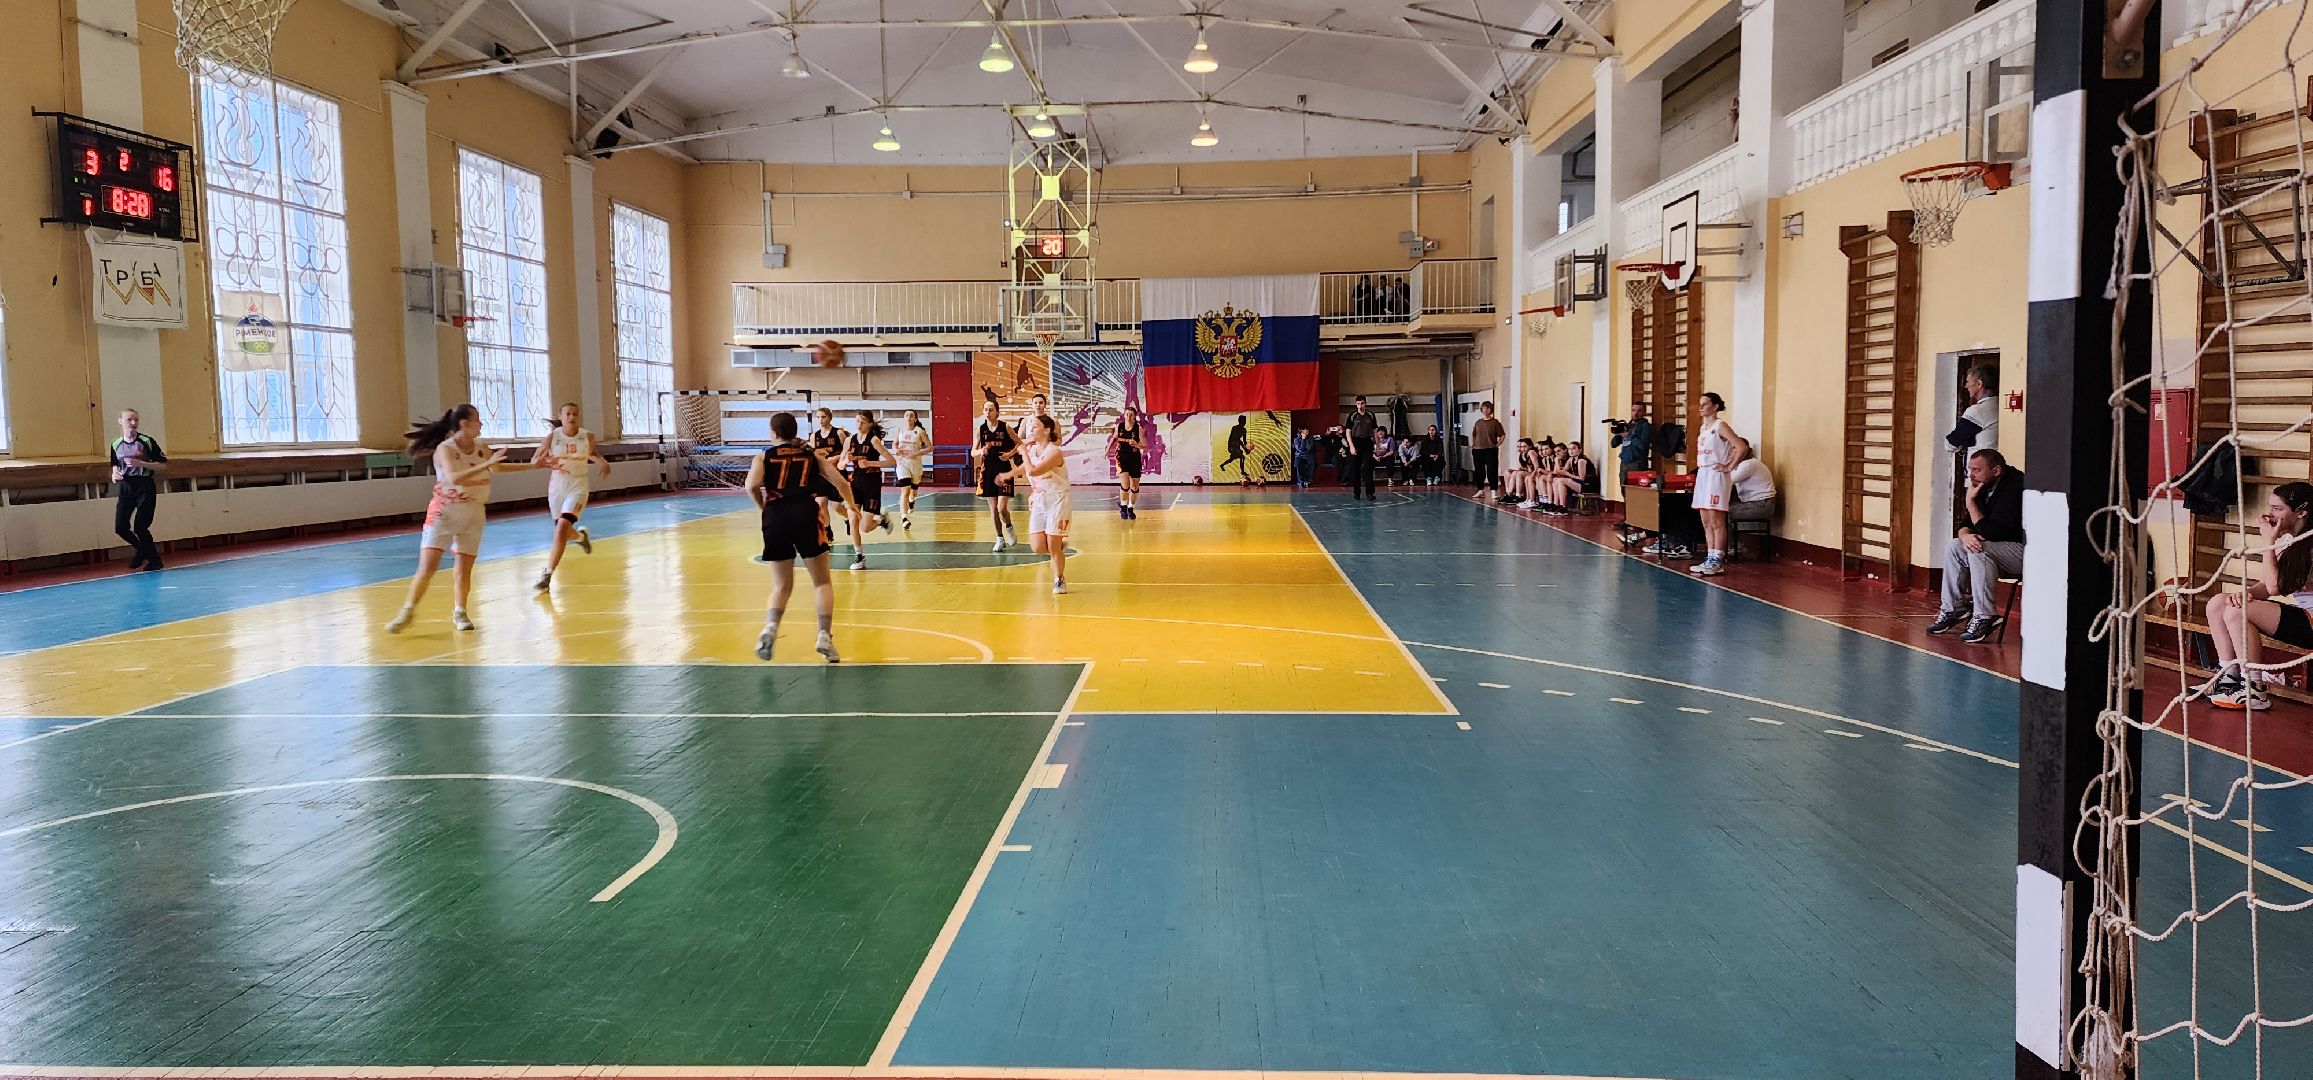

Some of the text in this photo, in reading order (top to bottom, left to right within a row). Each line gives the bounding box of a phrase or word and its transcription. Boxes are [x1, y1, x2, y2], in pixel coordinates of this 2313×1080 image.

[86, 150, 99, 175] 3
[119, 152, 129, 171] 2
[158, 167, 173, 191] 16
[770, 457, 809, 489] 77
[1709, 495, 1720, 505] 10
